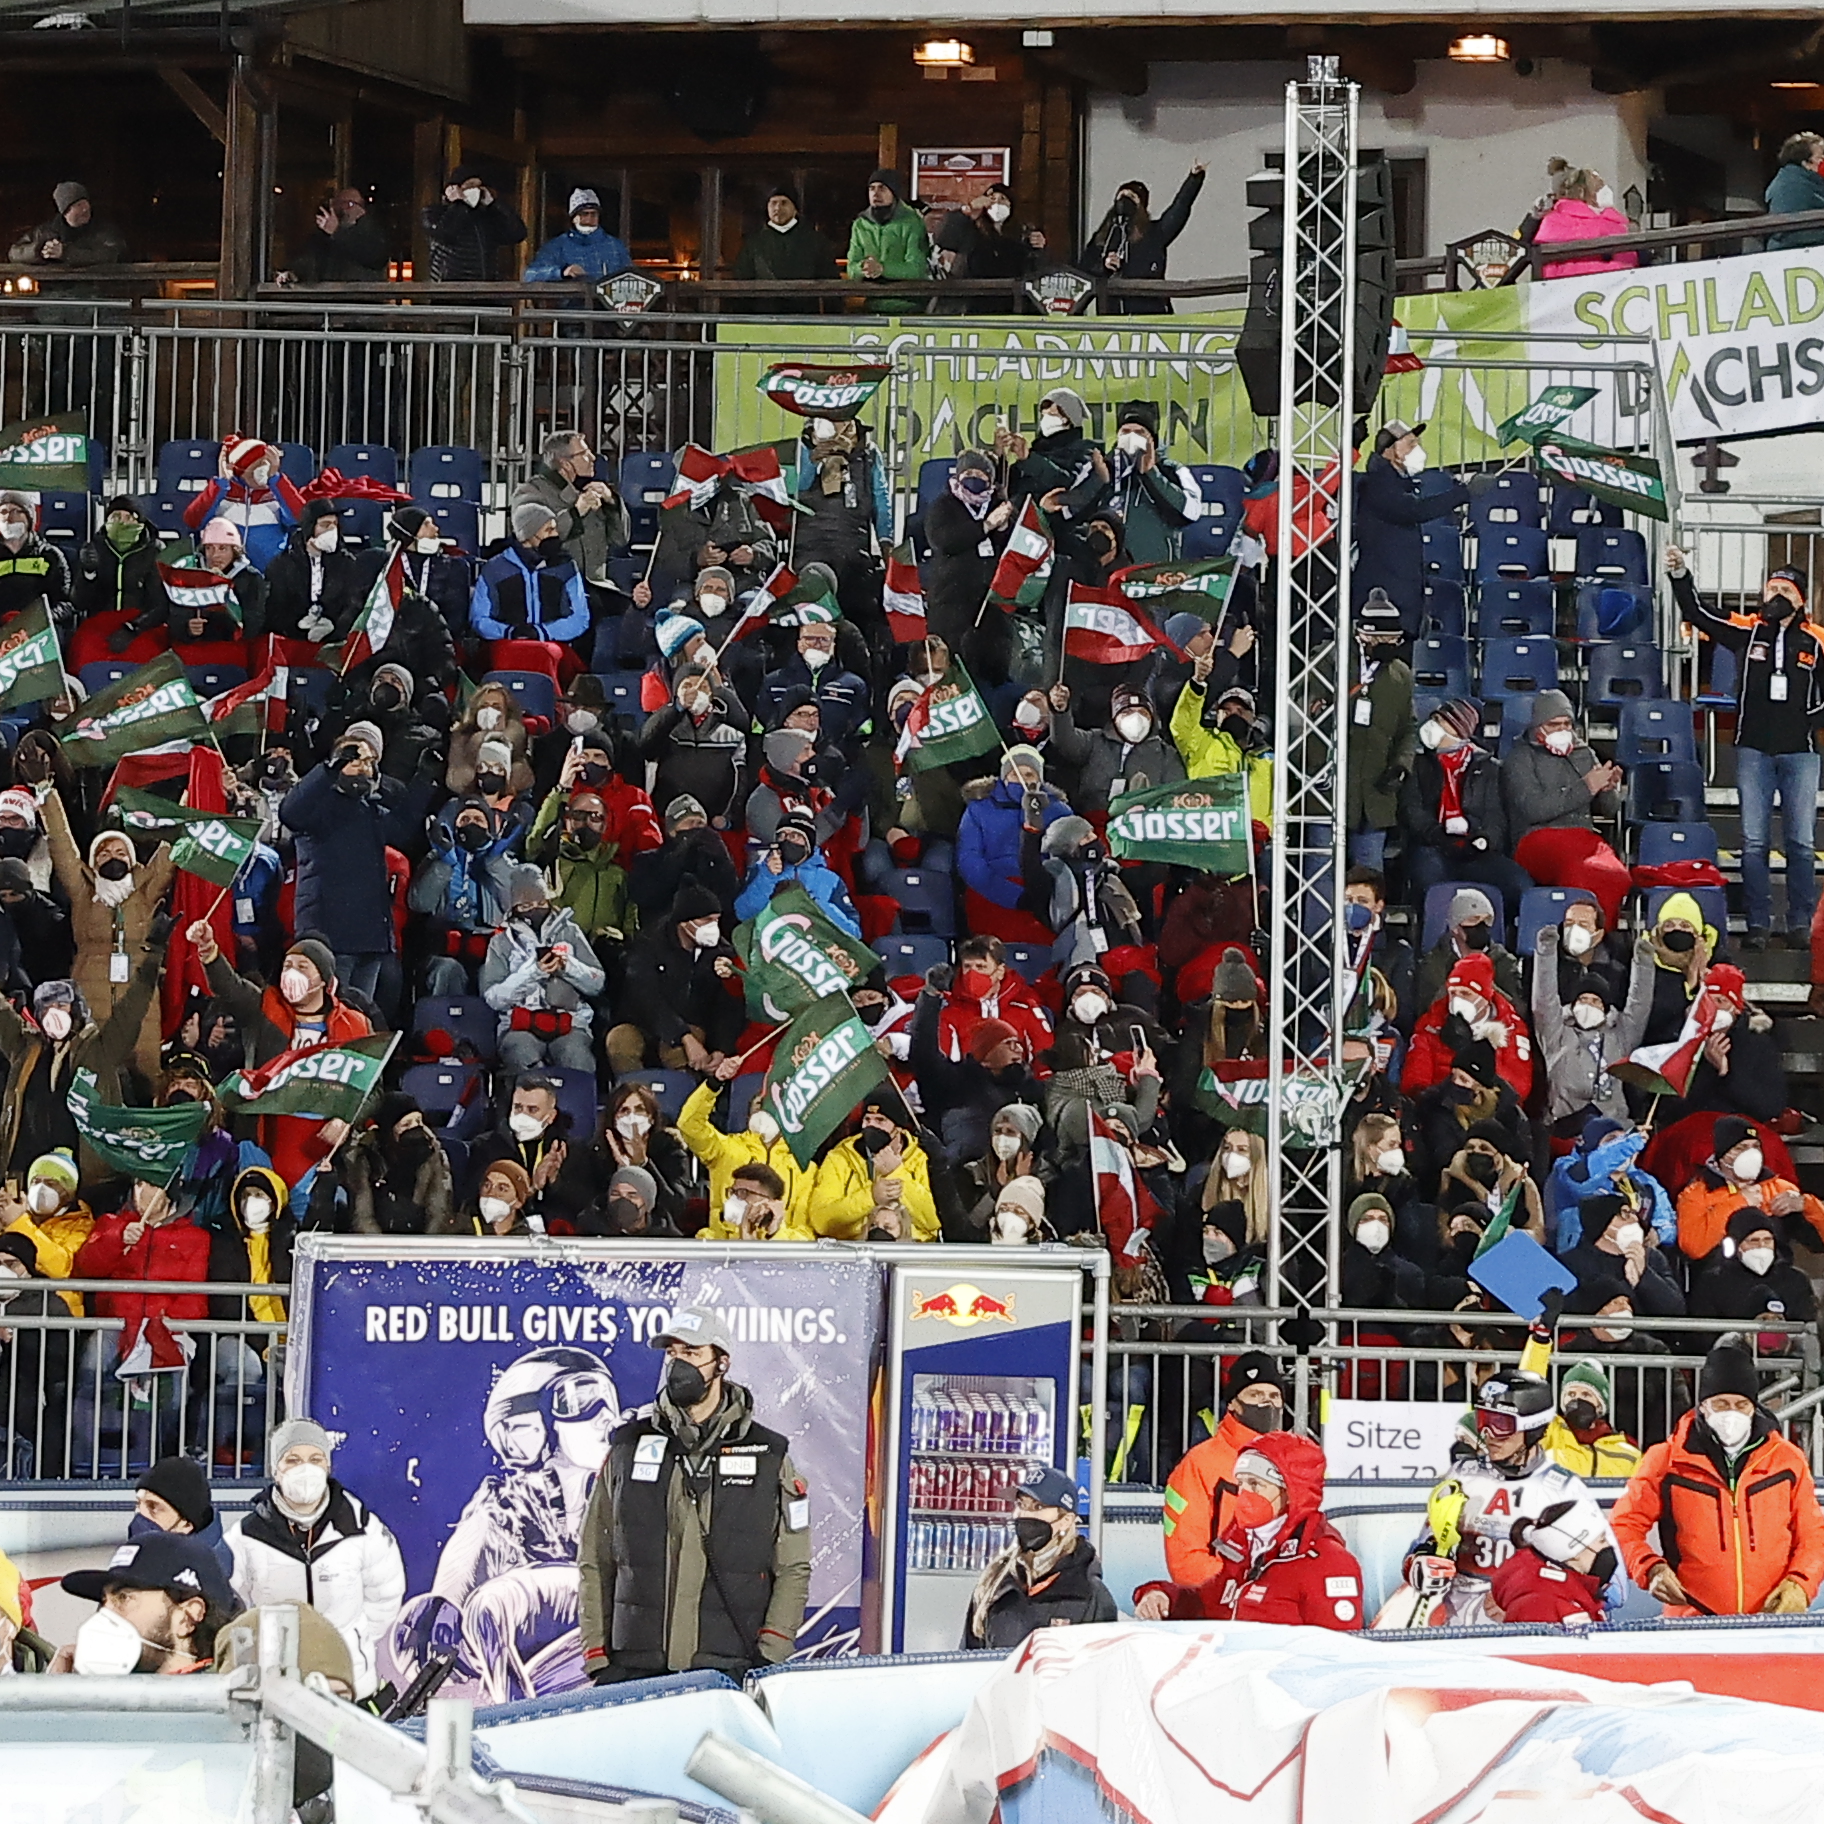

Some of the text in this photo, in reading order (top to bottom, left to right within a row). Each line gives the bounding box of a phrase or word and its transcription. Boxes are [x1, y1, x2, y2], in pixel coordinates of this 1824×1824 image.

[854, 331, 1238, 383] SCHLADMING
[1118, 805, 1239, 842] Gösser
[770, 1025, 856, 1134] Gösser
[365, 1304, 429, 1343] RED
[438, 1304, 513, 1343] BULL
[522, 1304, 618, 1343] GIVES
[627, 1305, 680, 1343] YO
[1346, 1420, 1422, 1450] Sitze
[725, 1458, 752, 1471] DNB
[1483, 1485, 1523, 1516] A1
[1475, 1535, 1519, 1569] 30
